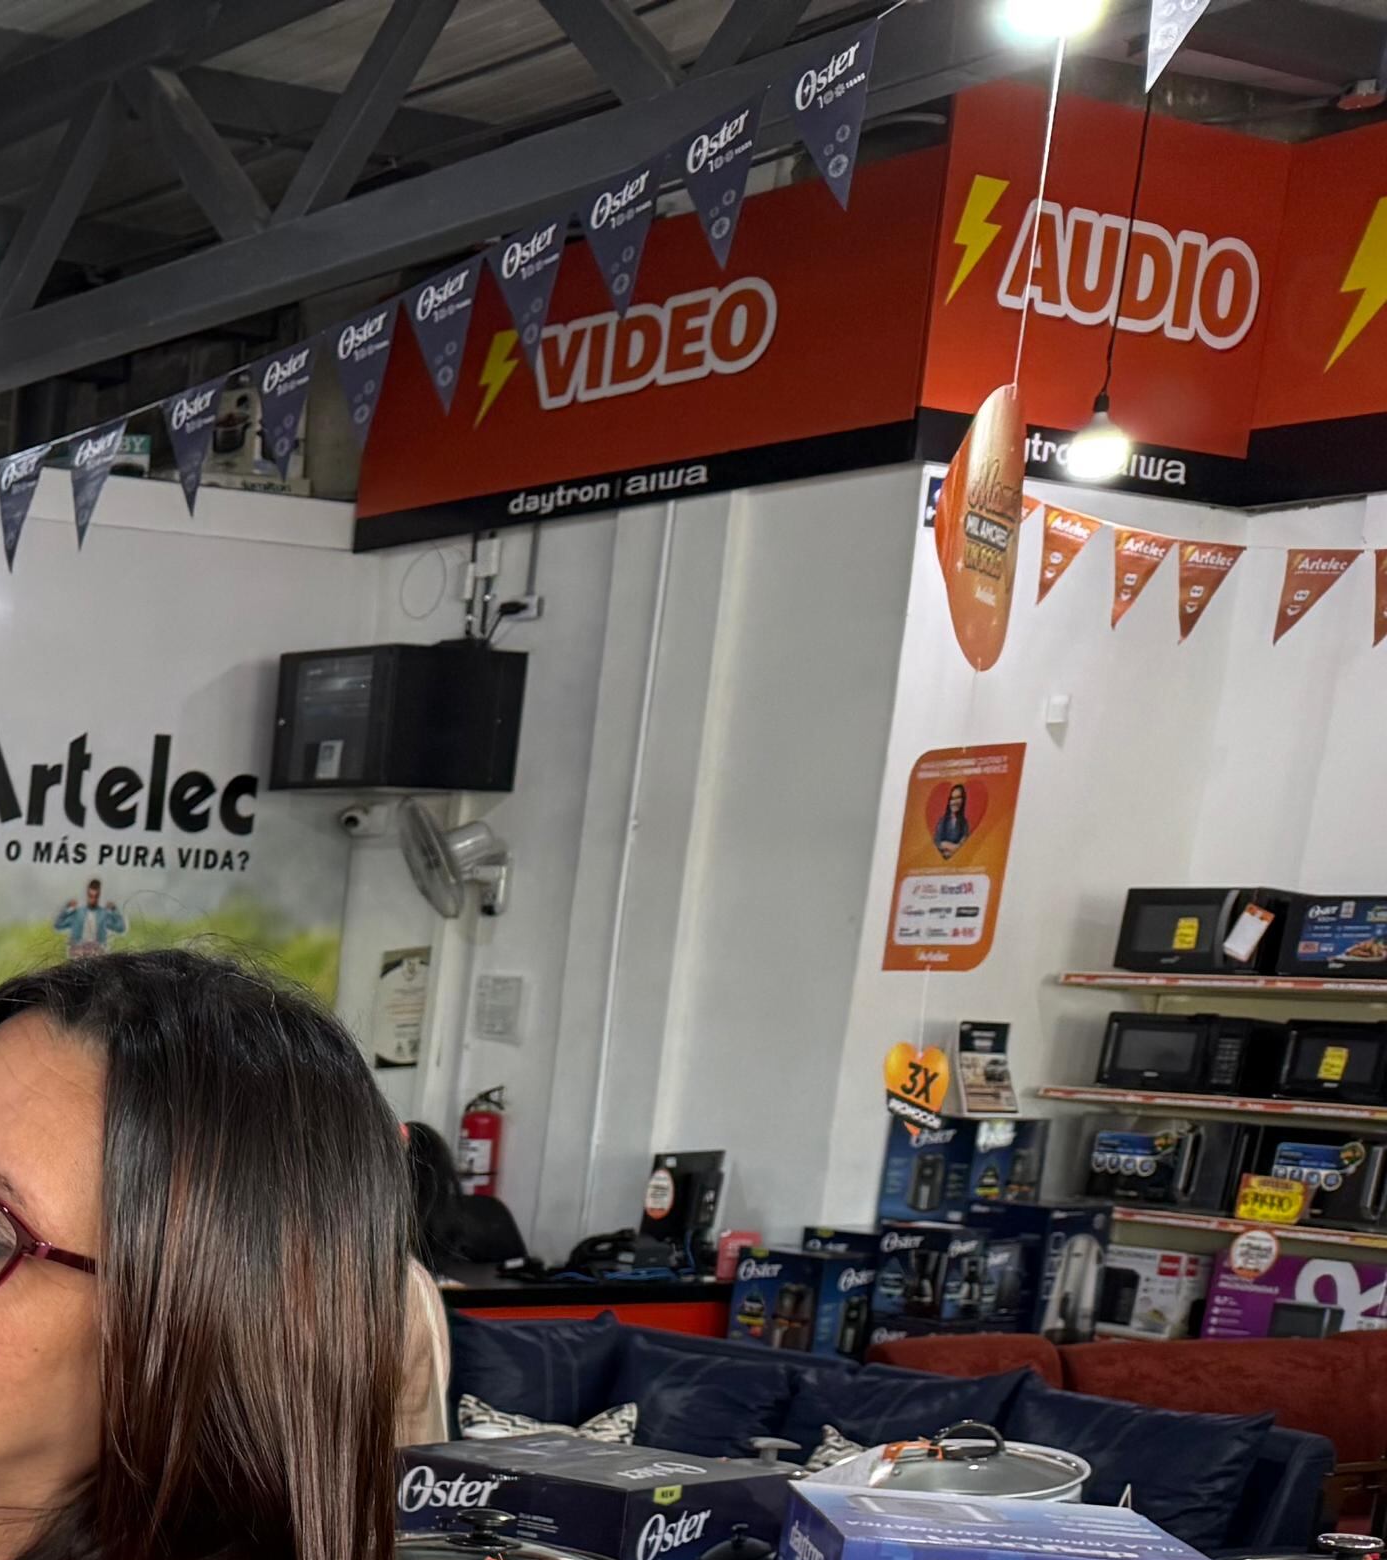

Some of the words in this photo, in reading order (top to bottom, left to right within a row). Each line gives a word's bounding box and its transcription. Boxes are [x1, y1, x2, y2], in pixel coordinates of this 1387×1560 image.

[795, 41, 861, 111] Oster
[686, 109, 750, 174] Oster
[590, 169, 650, 230] Oster
[501, 222, 557, 280] Oster
[415, 269, 470, 322] Oster
[997, 199, 1261, 352] AUDIO
[337, 310, 389, 361] Oster
[535, 276, 778, 411] VIDEO
[263, 348, 310, 396] Oster
[171, 387, 216, 431] Oster
[74, 429, 118, 468] Oster
[0, 457, 40, 491] Oster
[508, 482, 611, 516] daytron
[625, 464, 709, 496] aiwa
[1051, 518, 1091, 541] Artelec
[1124, 535, 1168, 560] Artelec
[1187, 546, 1235, 568] Artelec
[1297, 556, 1349, 572] Artelec
[5, 838, 23, 863] O
[32, 835, 88, 866] MÁS
[98, 842, 166, 870] PURA
[177, 847, 251, 873] VIDA?
[900, 1061, 940, 1105] 3X
[910, 1127, 957, 1149] Oster
[881, 1232, 926, 1253] Oster
[947, 1239, 980, 1258] Oster
[738, 1258, 783, 1282] Oster
[837, 1267, 877, 1292] Oster
[398, 1465, 500, 1514] Oster
